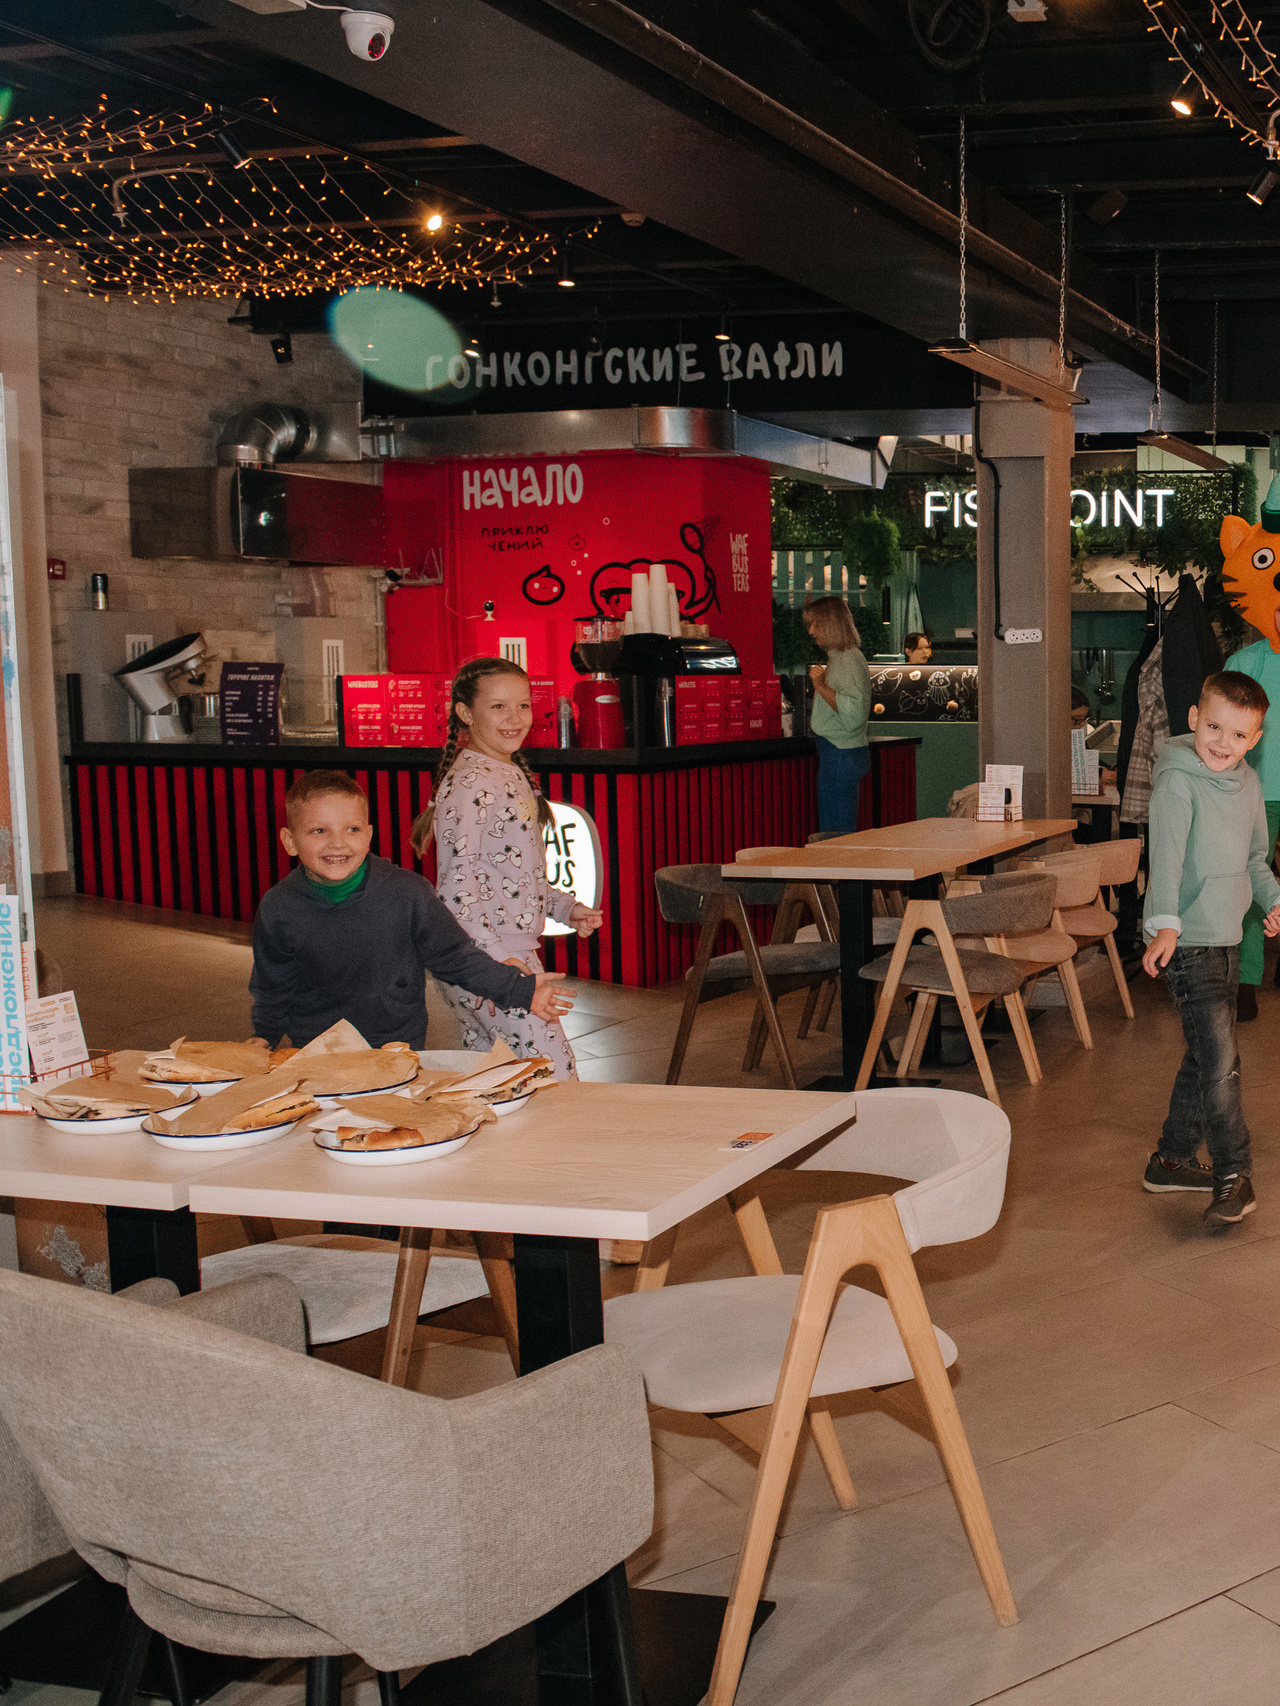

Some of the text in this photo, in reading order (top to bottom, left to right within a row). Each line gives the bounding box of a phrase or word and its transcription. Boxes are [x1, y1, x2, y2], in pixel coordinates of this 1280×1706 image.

[425, 340, 844, 389] ГОНКОНГСКИЕ ВАФЛИ
[924, 489, 1175, 528] FIS OINT
[481, 524, 550, 538] ПРИКЛЮ
[730, 532, 749, 555] WAF
[487, 537, 543, 551] ЧЕНИЙ
[731, 555, 749, 573] BUS
[545, 823, 576, 857] AF
[547, 859, 576, 887] US
